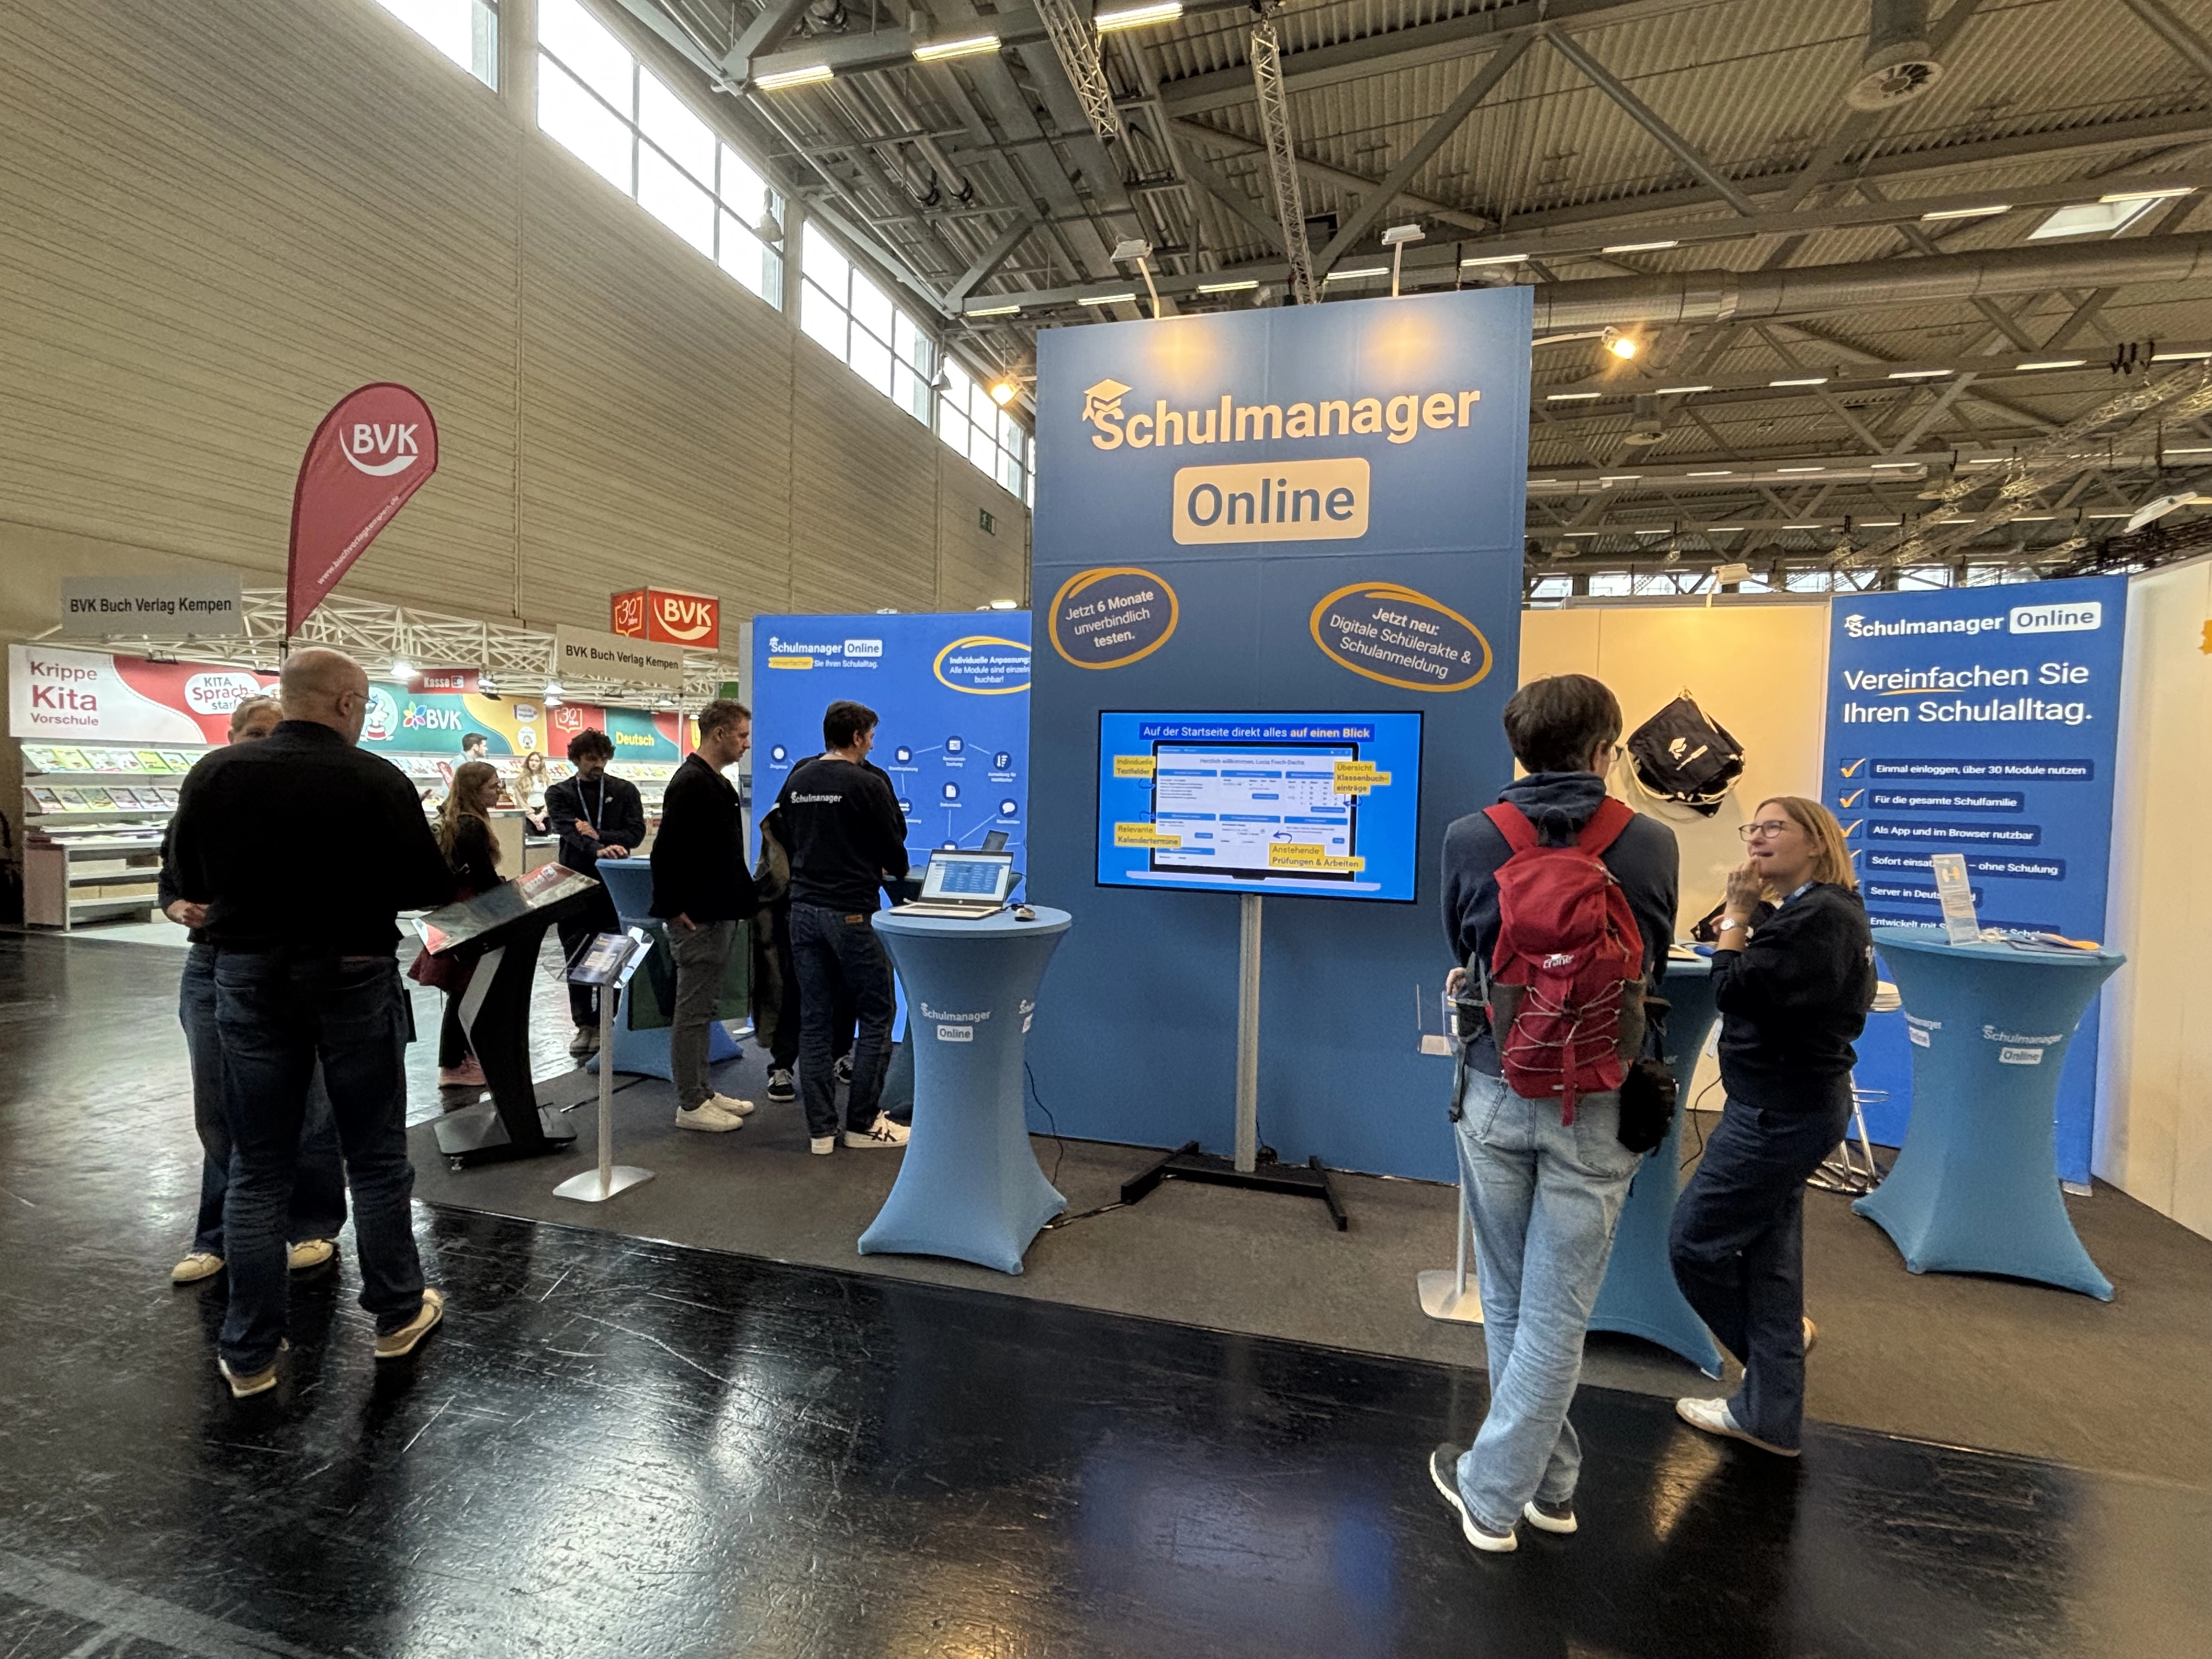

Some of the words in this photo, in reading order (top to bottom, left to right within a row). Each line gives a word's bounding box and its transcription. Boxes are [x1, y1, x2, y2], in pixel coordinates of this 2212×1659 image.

[1092, 390, 1481, 451] Schulmanager
[353, 424, 419, 454] BVK
[1187, 478, 1355, 527] Online
[70, 599, 96, 612] BVK
[100, 599, 132, 612] Buch
[136, 599, 174, 614] Verlag
[179, 597, 232, 614] Kempen
[618, 599, 636, 624] 30
[664, 599, 712, 627] BVK
[1065, 604, 1096, 620] Jetzt
[1097, 600, 1106, 612] 6
[1108, 591, 1154, 610] Monate
[1074, 607, 1150, 635] unverbindlich
[1372, 608, 1408, 627] Jetzt
[1409, 619, 1440, 636] neu:
[1848, 616, 2005, 637] Schulmanager
[2016, 609, 2095, 628] Online
[1093, 631, 1136, 647] testen.
[1330, 614, 1378, 637] Digitale
[1380, 629, 1458, 660] Schülerakte
[1460, 651, 1471, 665] &
[770, 641, 843, 656] Schulmanager
[847, 643, 880, 653] Online
[566, 645, 588, 658] BVK
[590, 648, 614, 661] Buch
[617, 651, 644, 667] Verlag
[646, 657, 679, 670] Kempen
[1340, 636, 1449, 680] Schulanmeldung
[30, 661, 98, 682] Krippe
[1843, 665, 2028, 691] Vereinfachen
[2039, 663, 2089, 685] Sie
[204, 677, 233, 687] KITA
[32, 685, 98, 712] Kita
[30, 713, 99, 726] Vorschule
[426, 709, 462, 731] BVK
[558, 707, 577, 724] 30
[1843, 703, 1909, 724] Ihren
[1917, 698, 2093, 726] Schulalltag.
[616, 732, 655, 746] Deutsch
[1143, 726, 1161, 737] Auf
[1163, 727, 1178, 737] der
[1182, 727, 1229, 738] Startseite
[1232, 727, 1261, 738] direkt
[1263, 727, 1288, 738] alles
[1290, 727, 1307, 738] auf
[1310, 728, 1340, 738] einen
[1342, 728, 1370, 738] Blick
[1337, 763, 1372, 771] Übersicht
[1876, 765, 1909, 774] Einmal
[1910, 765, 1960, 775] einloggen,
[1962, 765, 1986, 775] über
[1988, 766, 2002, 775] 30
[2005, 766, 2044, 775] Module
[2047, 767, 2086, 775] nutzen
[1336, 774, 1389, 782] Klassenbuch-
[1336, 784, 1367, 793] einträge
[791, 793, 843, 804] Schulmanager
[1874, 795, 1891, 804] Für
[1892, 795, 1907, 804] die
[1909, 797, 1952, 806] gesamte
[1954, 797, 2018, 807] Schulfamilie
[1118, 826, 1153, 834] Relevante
[1873, 826, 1888, 834] Als
[1891, 826, 1910, 837] App
[1912, 827, 1932, 836] und
[1933, 828, 1947, 837] im
[1949, 829, 1990, 838] Browser
[1993, 831, 2034, 840] nutzbar
[1118, 836, 1178, 845] Kalendertermine
[1272, 845, 1320, 855] Anstehende
[1272, 856, 1313, 866] Prüfungen
[1316, 858, 1322, 866] &
[1323, 859, 1359, 868] Arbeiten
[1872, 856, 1901, 865] Sofort
[1978, 862, 2005, 871] ohne
[2007, 863, 2058, 876] Schulung
[1870, 887, 1900, 896] Server
[1903, 889, 1912, 897] in
[1870, 917, 1918, 928] Entwickelt
[922, 1007, 991, 1023] Schulmanager
[939, 1028, 971, 1039] Online
[2004, 1050, 2039, 1060] Online
